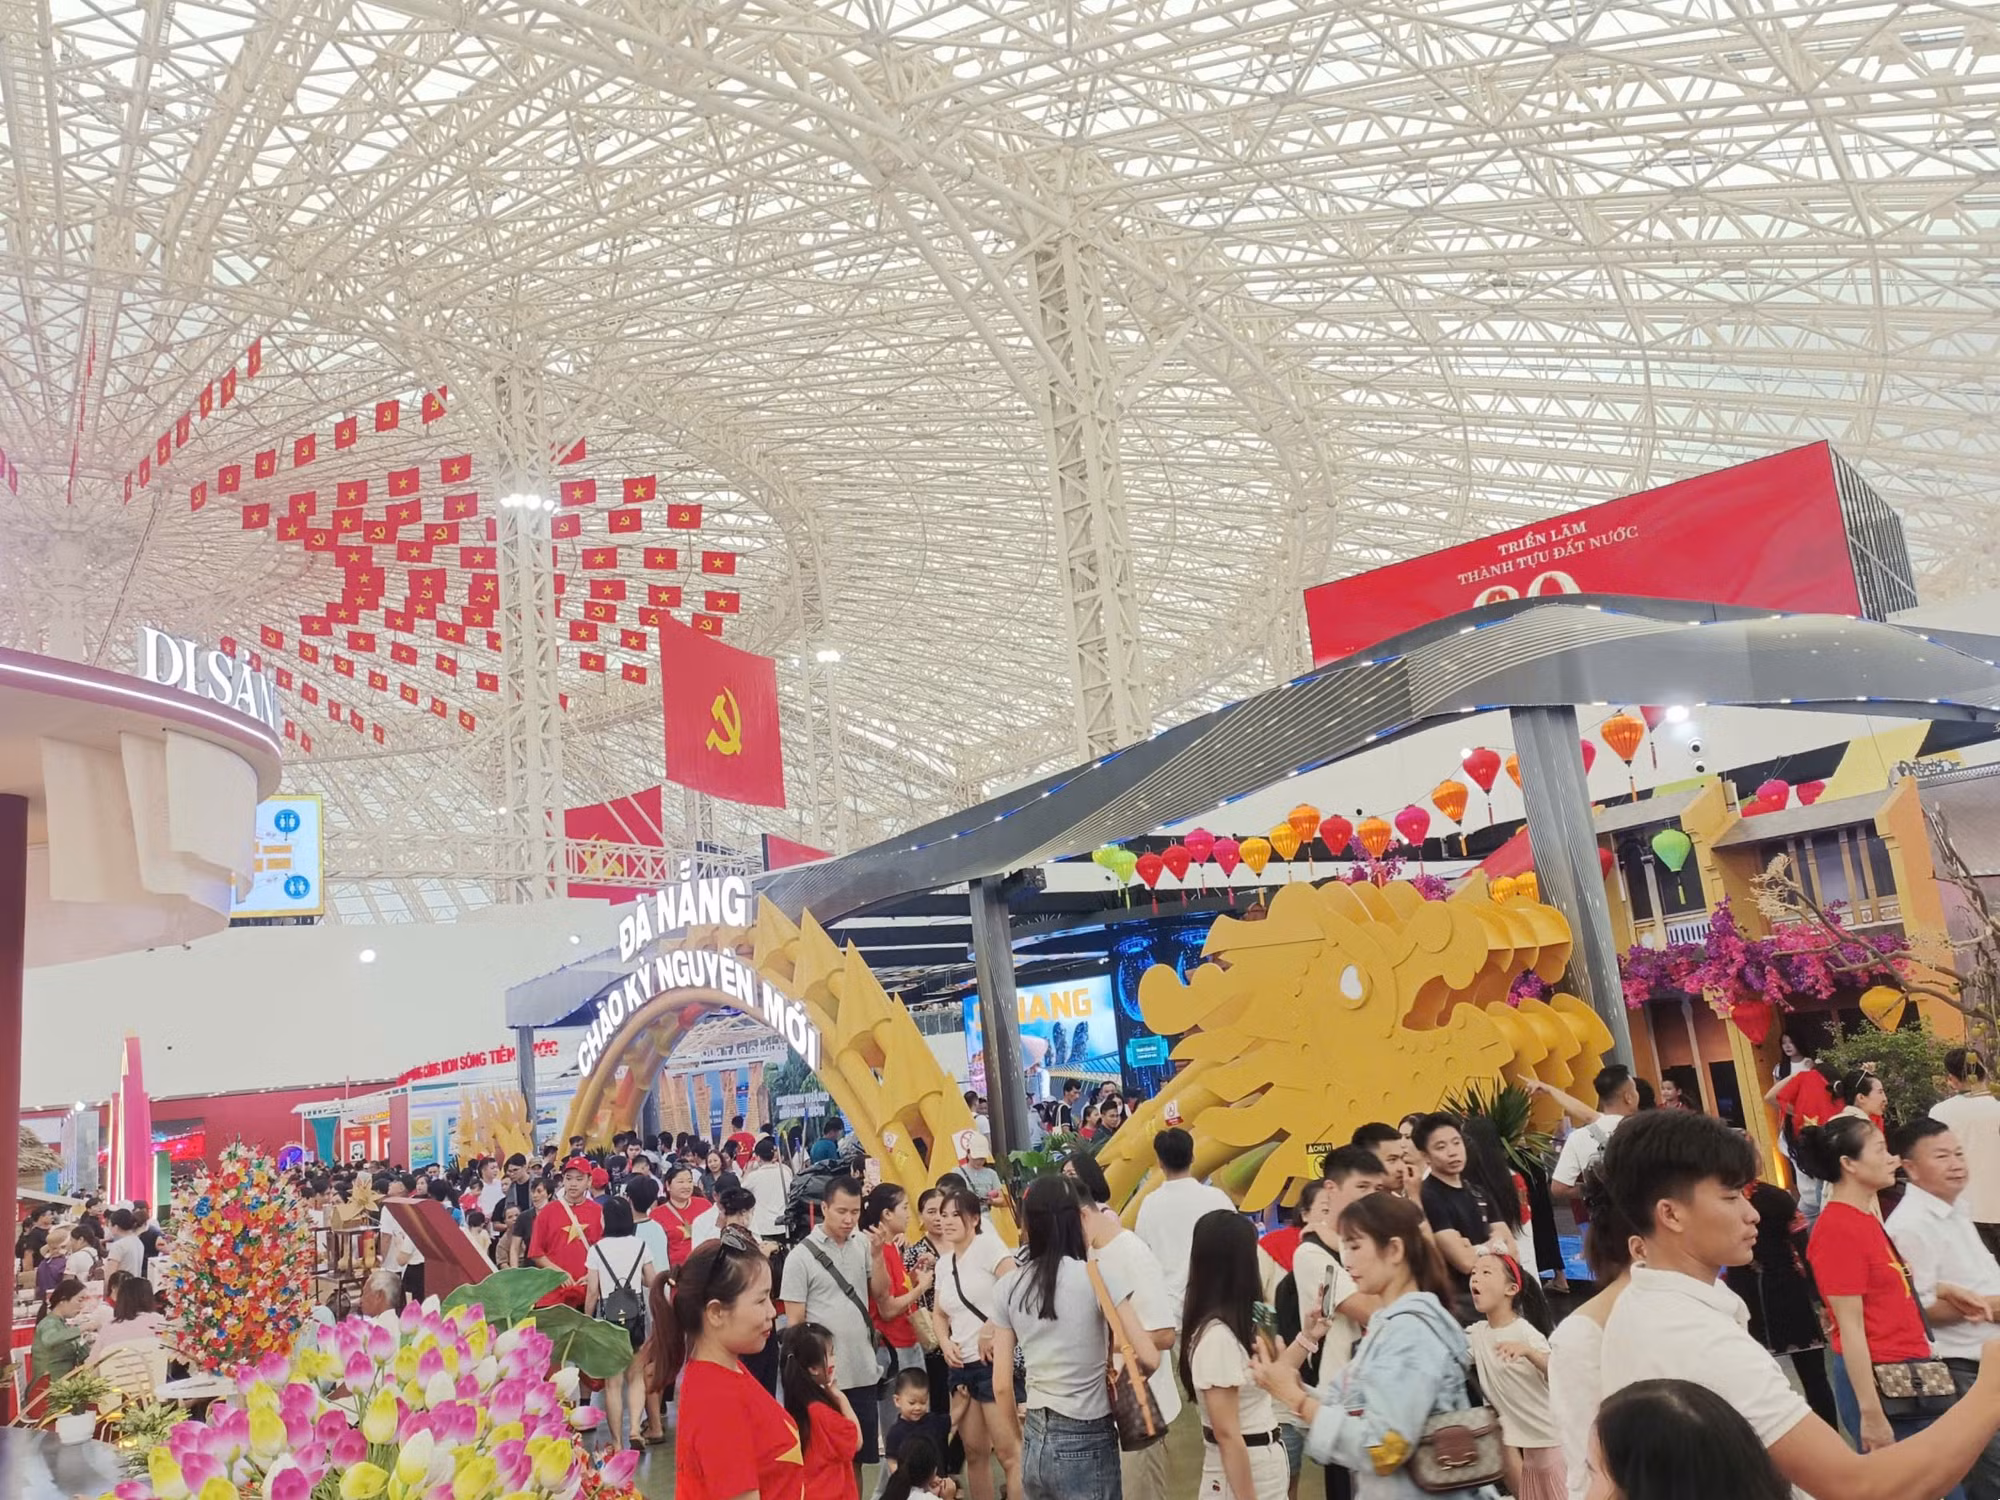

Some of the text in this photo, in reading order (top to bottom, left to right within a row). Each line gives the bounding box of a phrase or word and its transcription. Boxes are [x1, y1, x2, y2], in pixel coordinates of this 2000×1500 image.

[1457, 561, 1515, 585] THÀNH
[1516, 551, 1550, 568] TỰU
[1552, 538, 1586, 560] ĐẤT
[1589, 526, 1639, 549] NƯỚC
[1498, 521, 1588, 556] TRIỂN LÃM
[142, 626, 275, 728] DI SẢN
[618, 858, 747, 963] ĐÀ NẴNG
[577, 990, 626, 1077] CHÀO
[655, 948, 755, 1008] NGUYÊN
[762, 982, 818, 1073] MỚI
[459, 1052, 487, 1070] SÔNG
